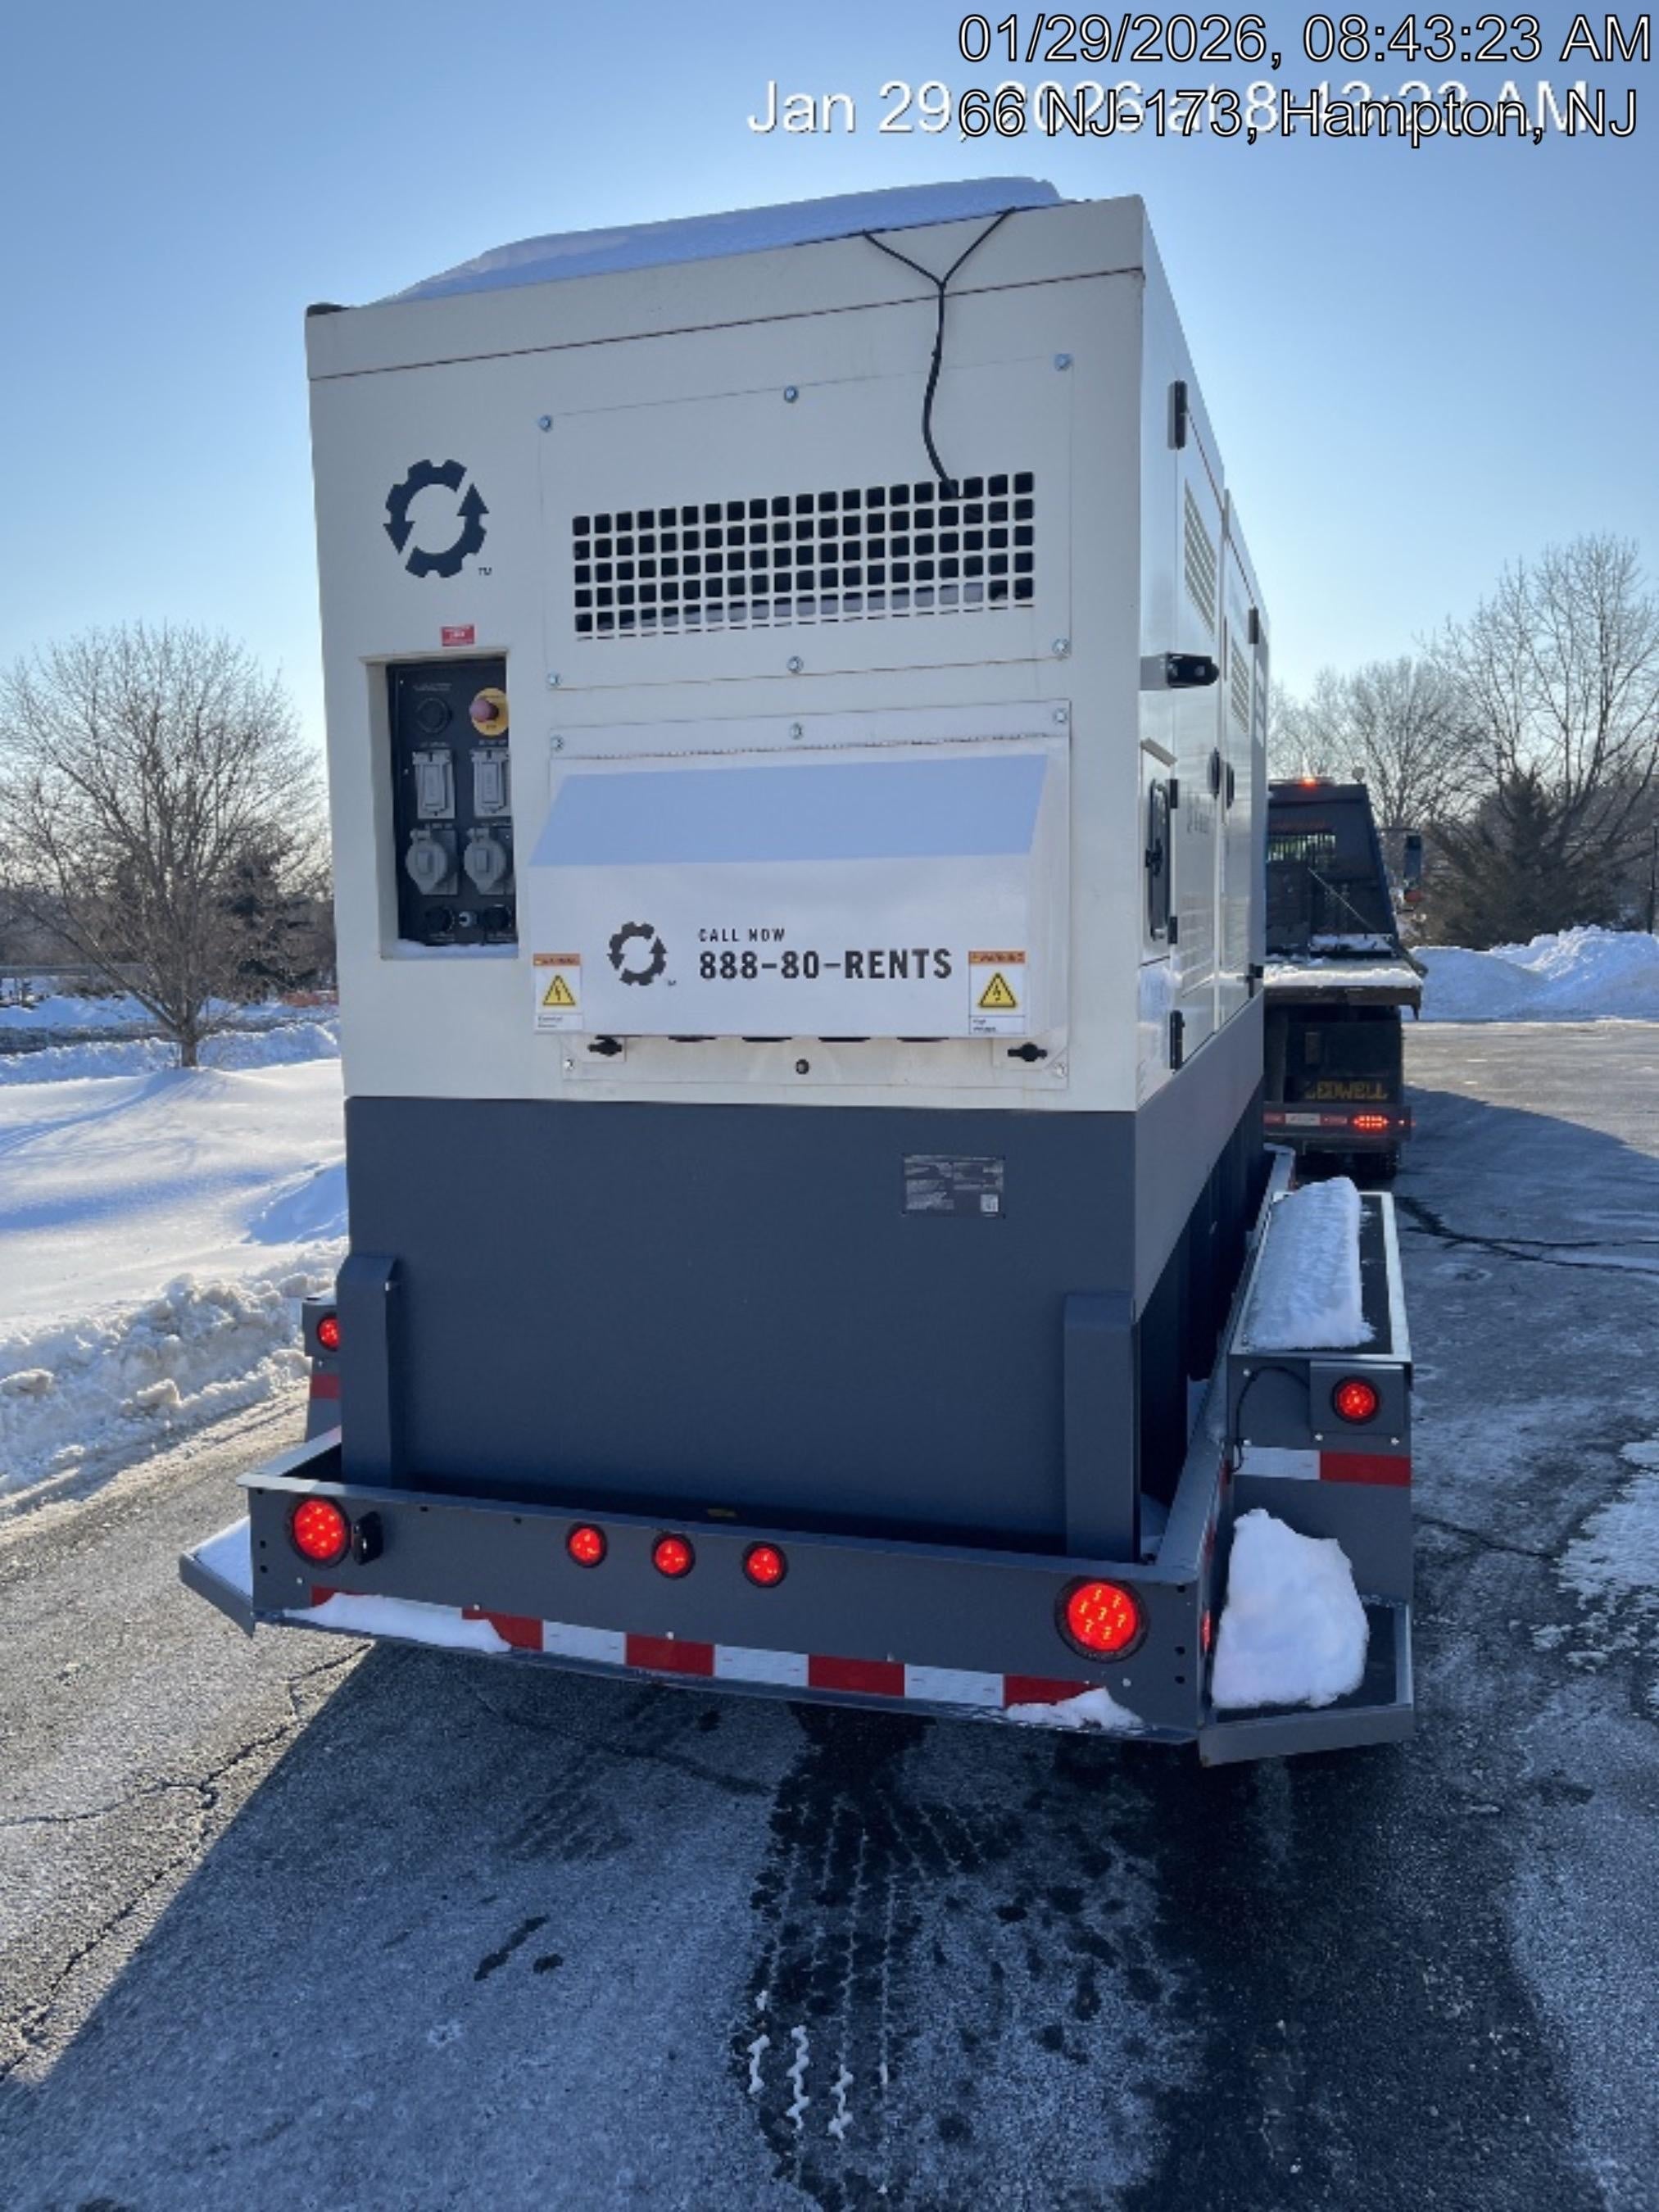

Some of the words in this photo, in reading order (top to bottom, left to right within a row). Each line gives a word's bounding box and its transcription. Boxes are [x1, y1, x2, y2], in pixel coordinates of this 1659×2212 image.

[699, 928, 740, 942] CALL
[749, 928, 786, 942] NOW
[699, 948, 953, 980] 888-80-RENTS
